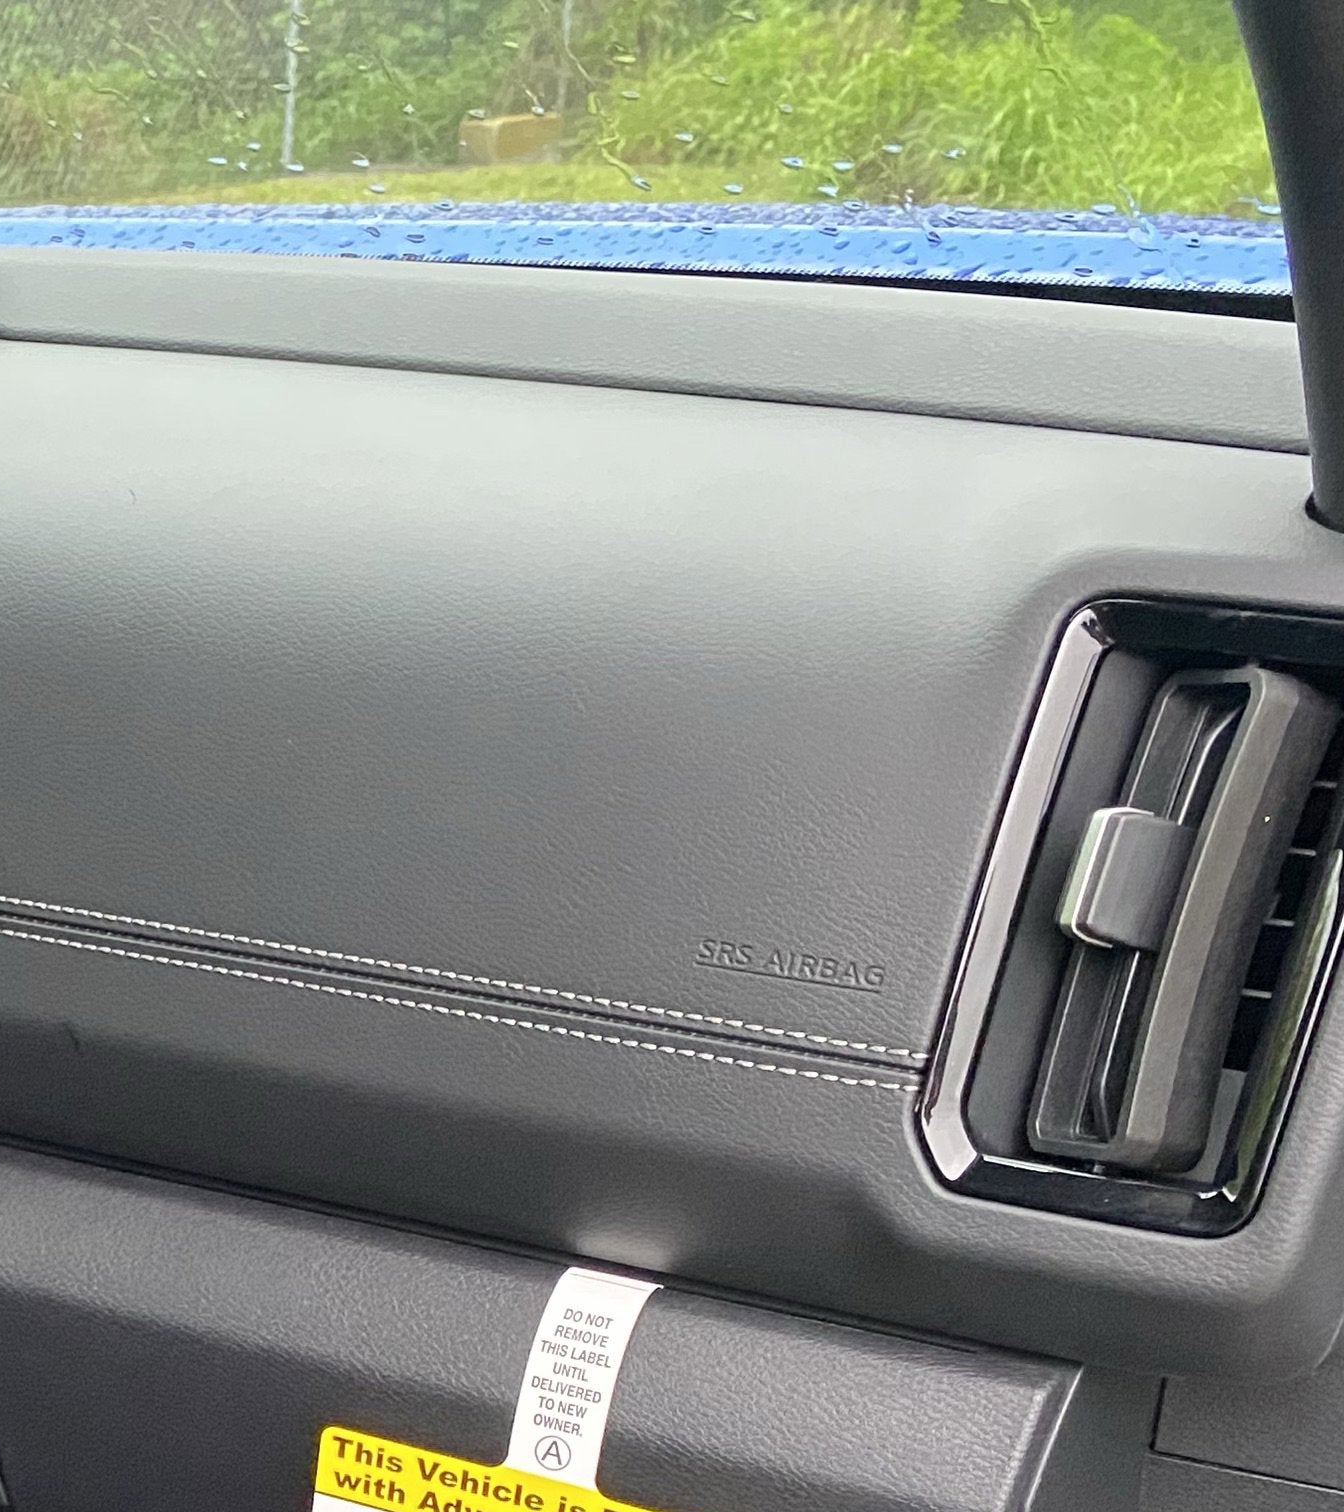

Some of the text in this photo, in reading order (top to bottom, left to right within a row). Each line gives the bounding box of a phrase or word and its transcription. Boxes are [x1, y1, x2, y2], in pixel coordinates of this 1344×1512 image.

[694, 938, 886, 987] SRS AIRBAG
[563, 1308, 614, 1330] DO NOT
[554, 1324, 609, 1348] REMOVE
[540, 1340, 611, 1368] THIS LABEL
[552, 1362, 588, 1382] UNTIL
[531, 1375, 602, 1404] DELIVERED
[538, 1396, 588, 1419] TO NEW
[533, 1413, 582, 1437] OWNER.
[541, 1440, 562, 1465] A
[333, 1436, 403, 1473] This
[417, 1457, 545, 1511] Vehicle
[334, 1471, 405, 1504] with
